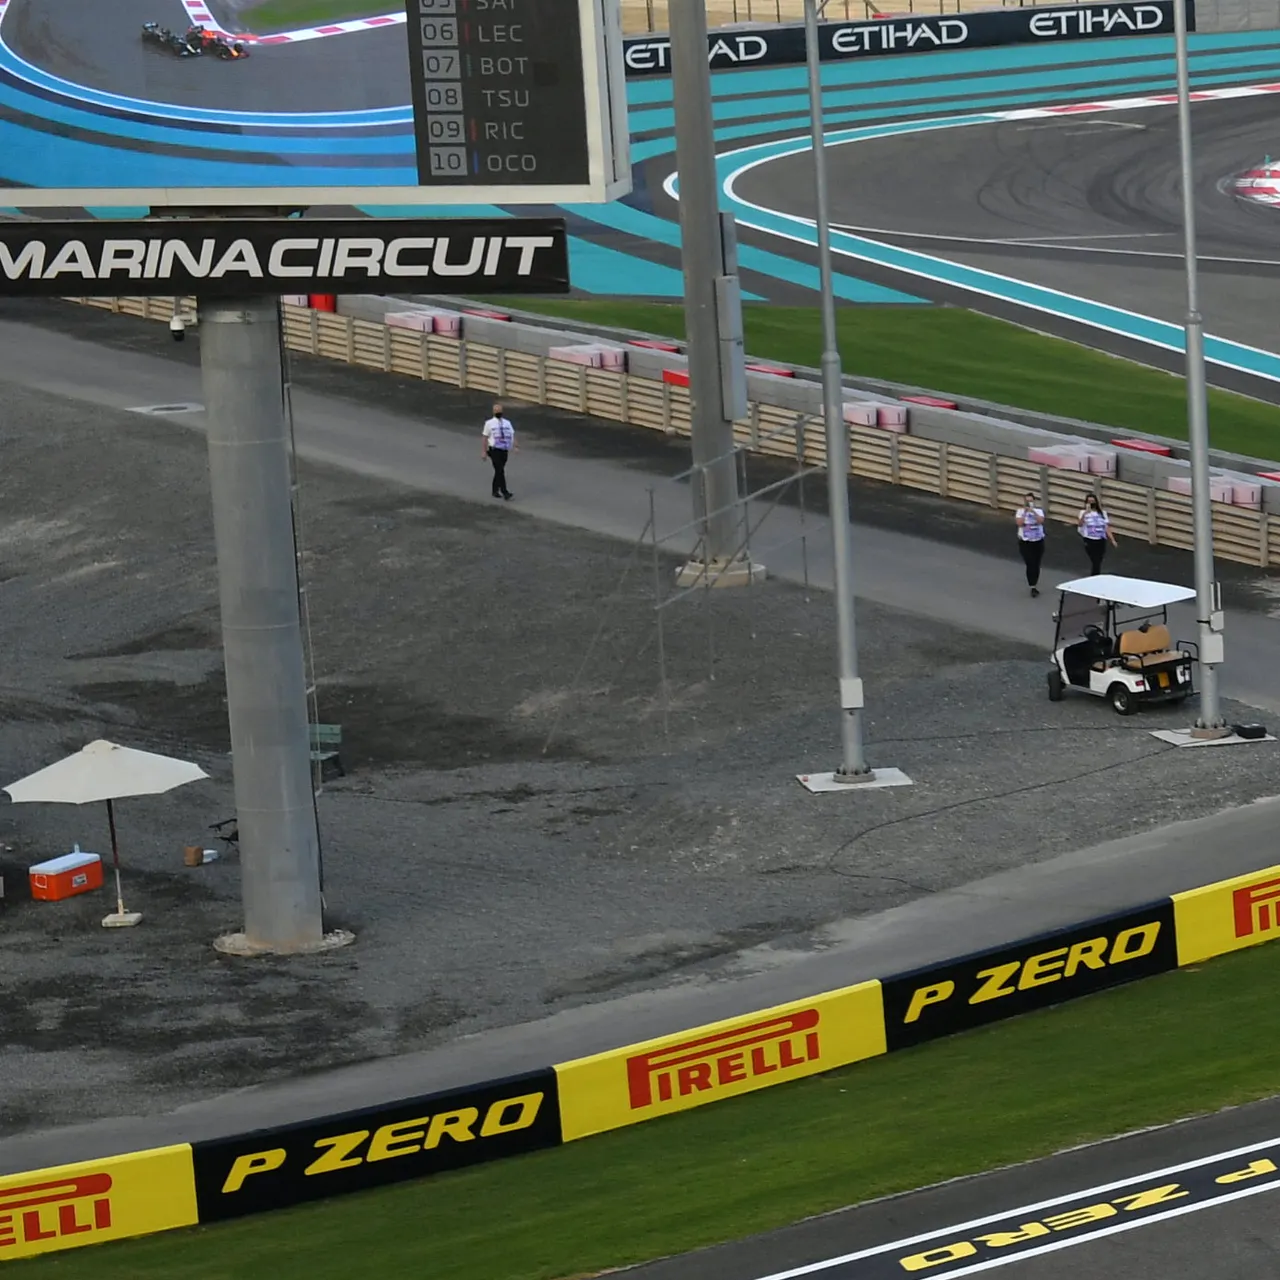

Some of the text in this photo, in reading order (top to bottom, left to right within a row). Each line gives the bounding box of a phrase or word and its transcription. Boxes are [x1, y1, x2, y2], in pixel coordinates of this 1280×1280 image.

[422, 23, 523, 42] 06 LEC
[832, 20, 968, 52] ETIHAD
[1029, 6, 1163, 36] ETIHAD
[426, 56, 529, 75] 07 BOT
[625, 36, 767, 69] ETAD
[428, 88, 530, 107] 08 TSU
[430, 121, 525, 140] 09 RIC
[434, 153, 537, 172] 10 OCO
[0, 236, 554, 280] MARINA CIRCUIT
[903, 921, 1161, 1024] P ZERO
[626, 1008, 820, 1109] PIRELLI
[222, 1091, 544, 1194] P ZERO
[899, 1158, 1278, 1272] P ZERO
